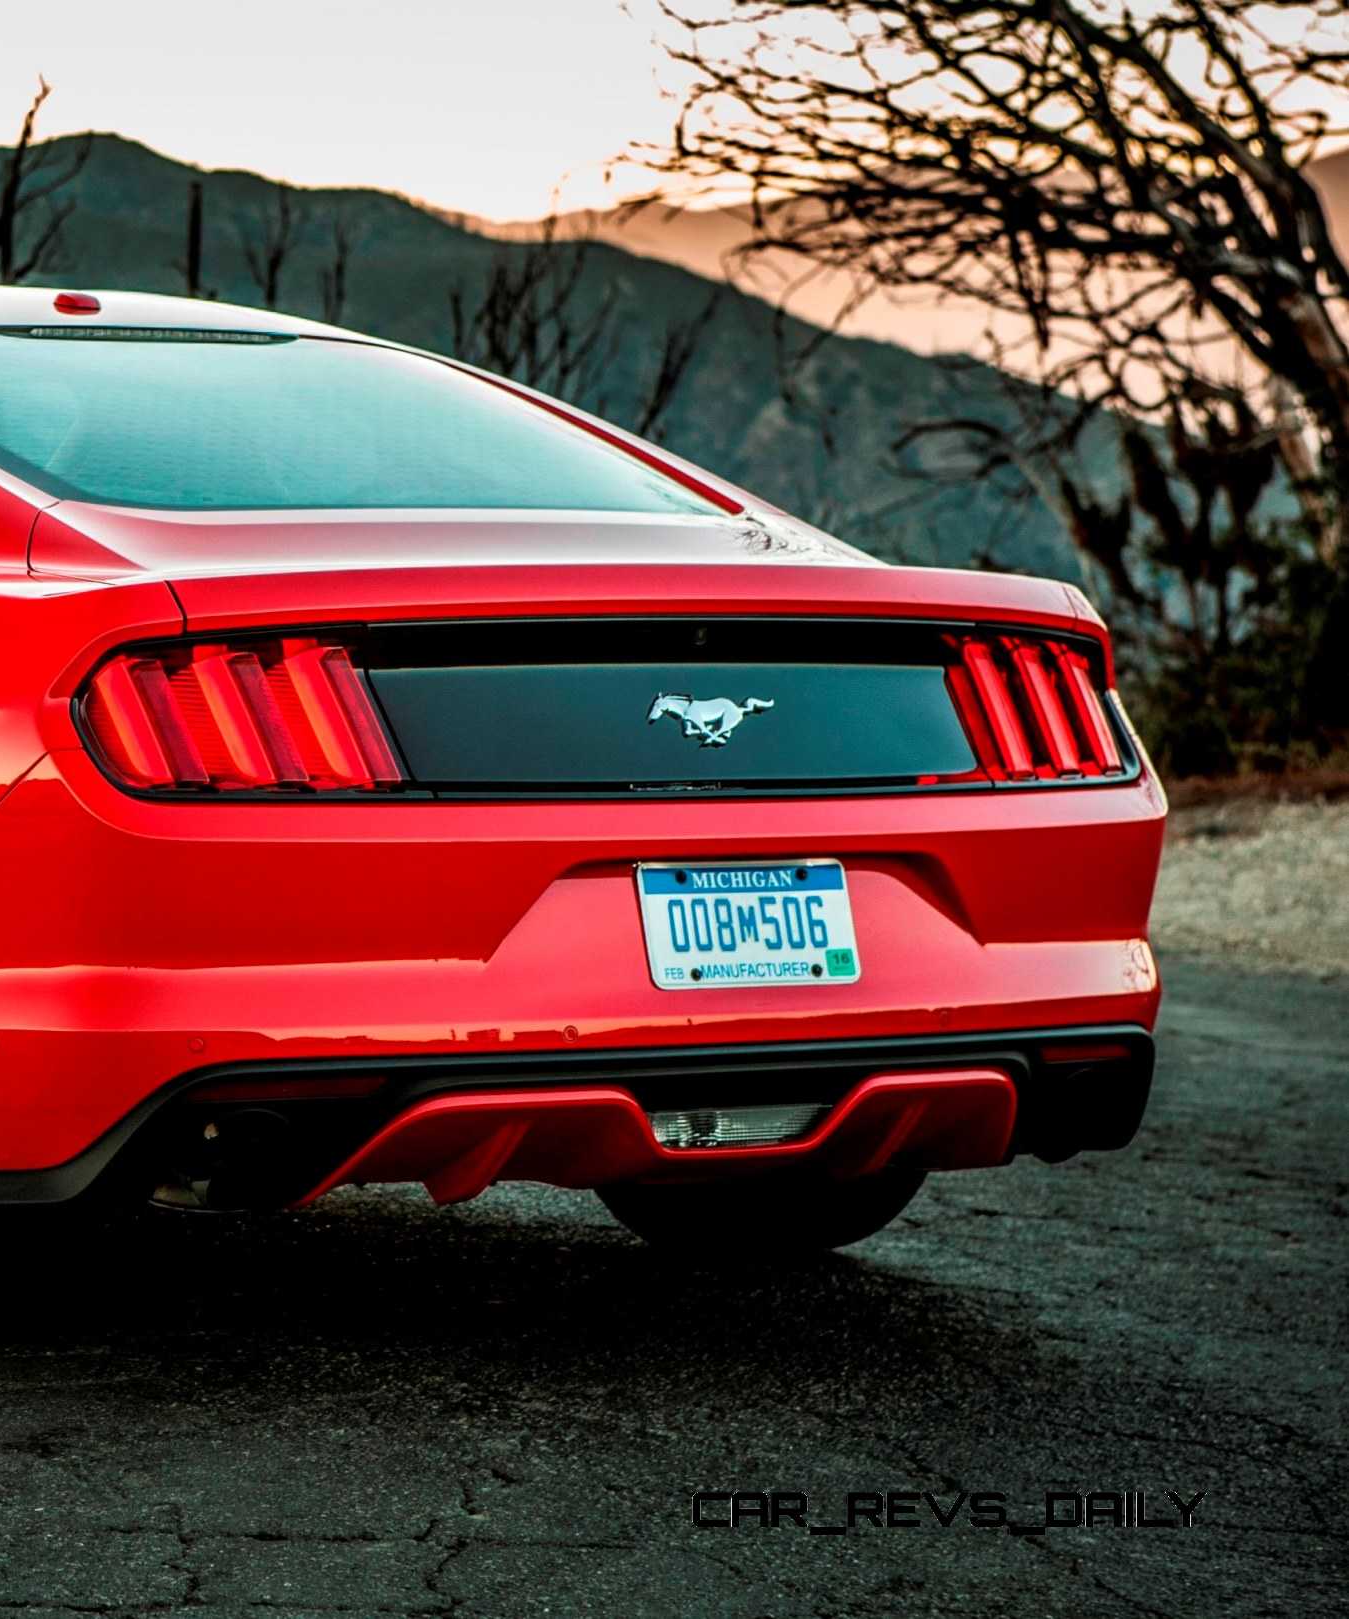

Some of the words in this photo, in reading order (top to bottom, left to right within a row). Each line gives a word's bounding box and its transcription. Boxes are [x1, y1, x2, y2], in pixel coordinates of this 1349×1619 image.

[691, 870, 793, 889] MICHIGAN
[667, 895, 829, 952] 008M506
[833, 952, 850, 965] 16
[664, 967, 685, 980] FEB
[700, 961, 810, 979] MANUFACTURER
